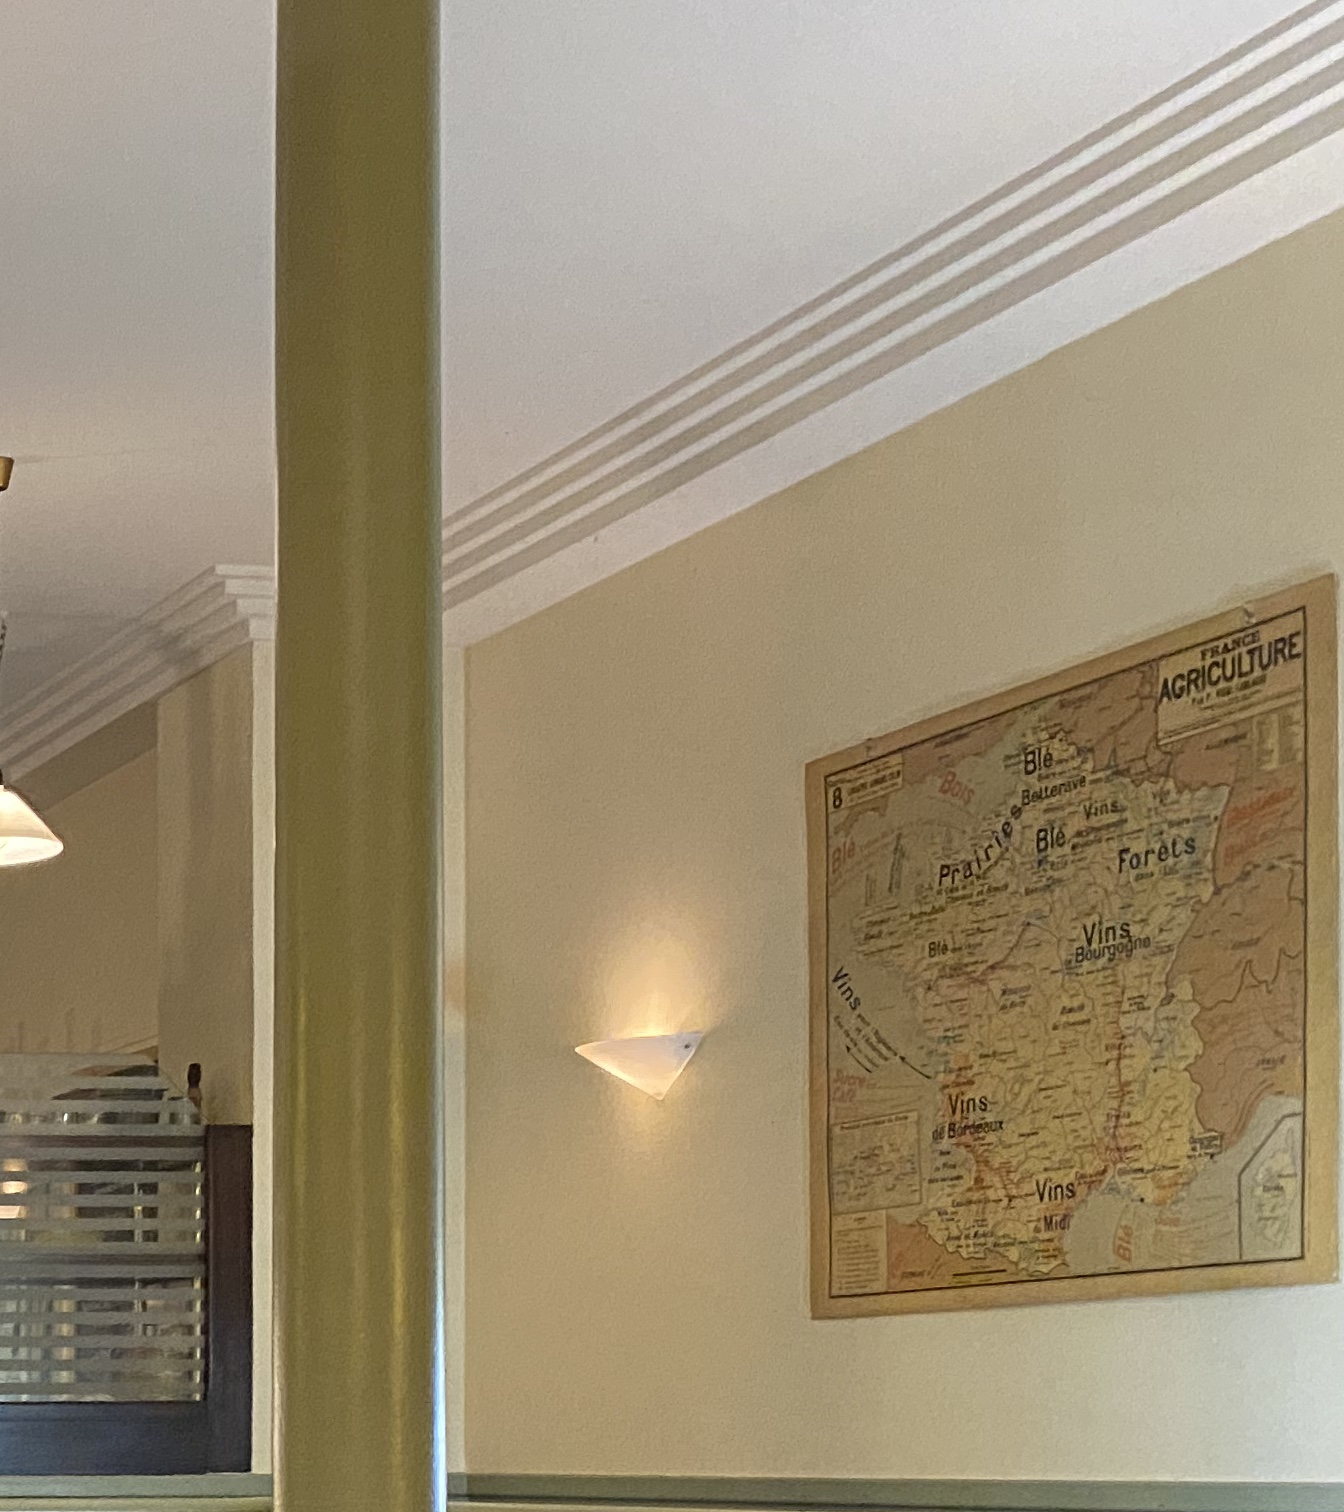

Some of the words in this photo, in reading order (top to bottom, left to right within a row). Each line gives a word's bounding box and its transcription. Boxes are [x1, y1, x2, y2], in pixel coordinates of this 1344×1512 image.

[1199, 629, 1261, 661] FRANCE
[1158, 631, 1302, 705] AGRICULTURE
[1023, 746, 1054, 776] Blé
[831, 786, 844, 810] 8
[938, 770, 976, 806] Bois
[938, 803, 1024, 887] Prairies
[1036, 826, 1067, 853] Blé
[1083, 917, 1131, 947] Vins
[1074, 934, 1152, 965] Bourgogne
[831, 965, 862, 1012] Vins
[948, 1091, 989, 1116] Vins
[947, 1120, 1005, 1140] Bordeaux
[1035, 1178, 1077, 1203] Vins
